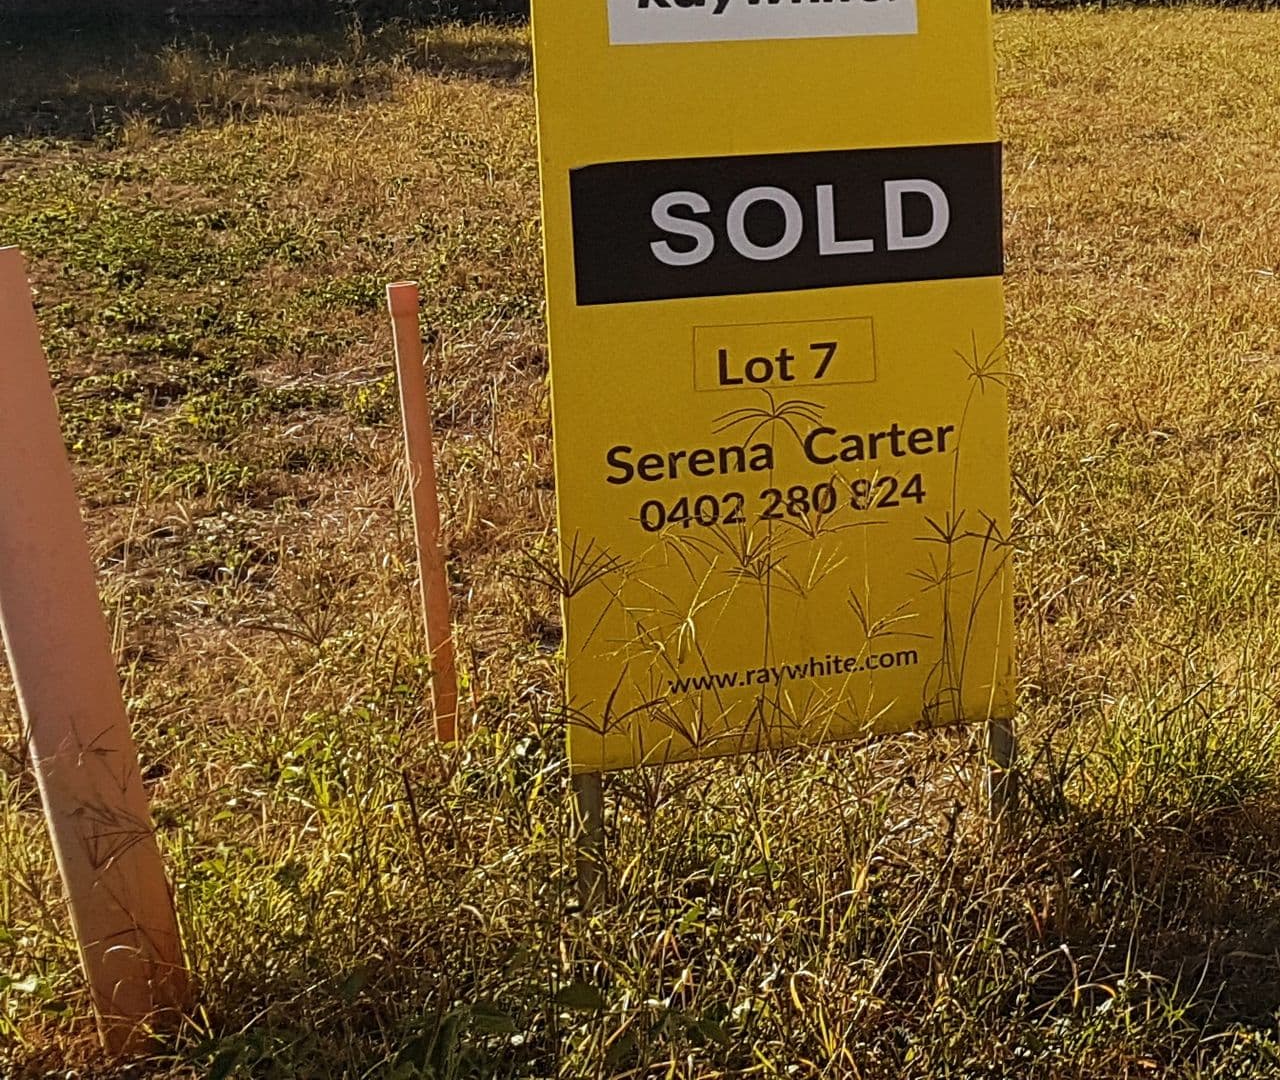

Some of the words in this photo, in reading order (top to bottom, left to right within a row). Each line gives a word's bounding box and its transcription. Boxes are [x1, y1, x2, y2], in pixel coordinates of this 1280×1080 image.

[649, 178, 951, 266] SOLD
[717, 347, 795, 386] Lot
[808, 342, 838, 379] 7
[605, 441, 774, 485] Serena
[802, 423, 955, 466] Carter
[638, 491, 746, 533] 0402
[758, 482, 837, 520] 280
[849, 473, 926, 510] 824
[668, 646, 919, 695] www.raywhite.com
